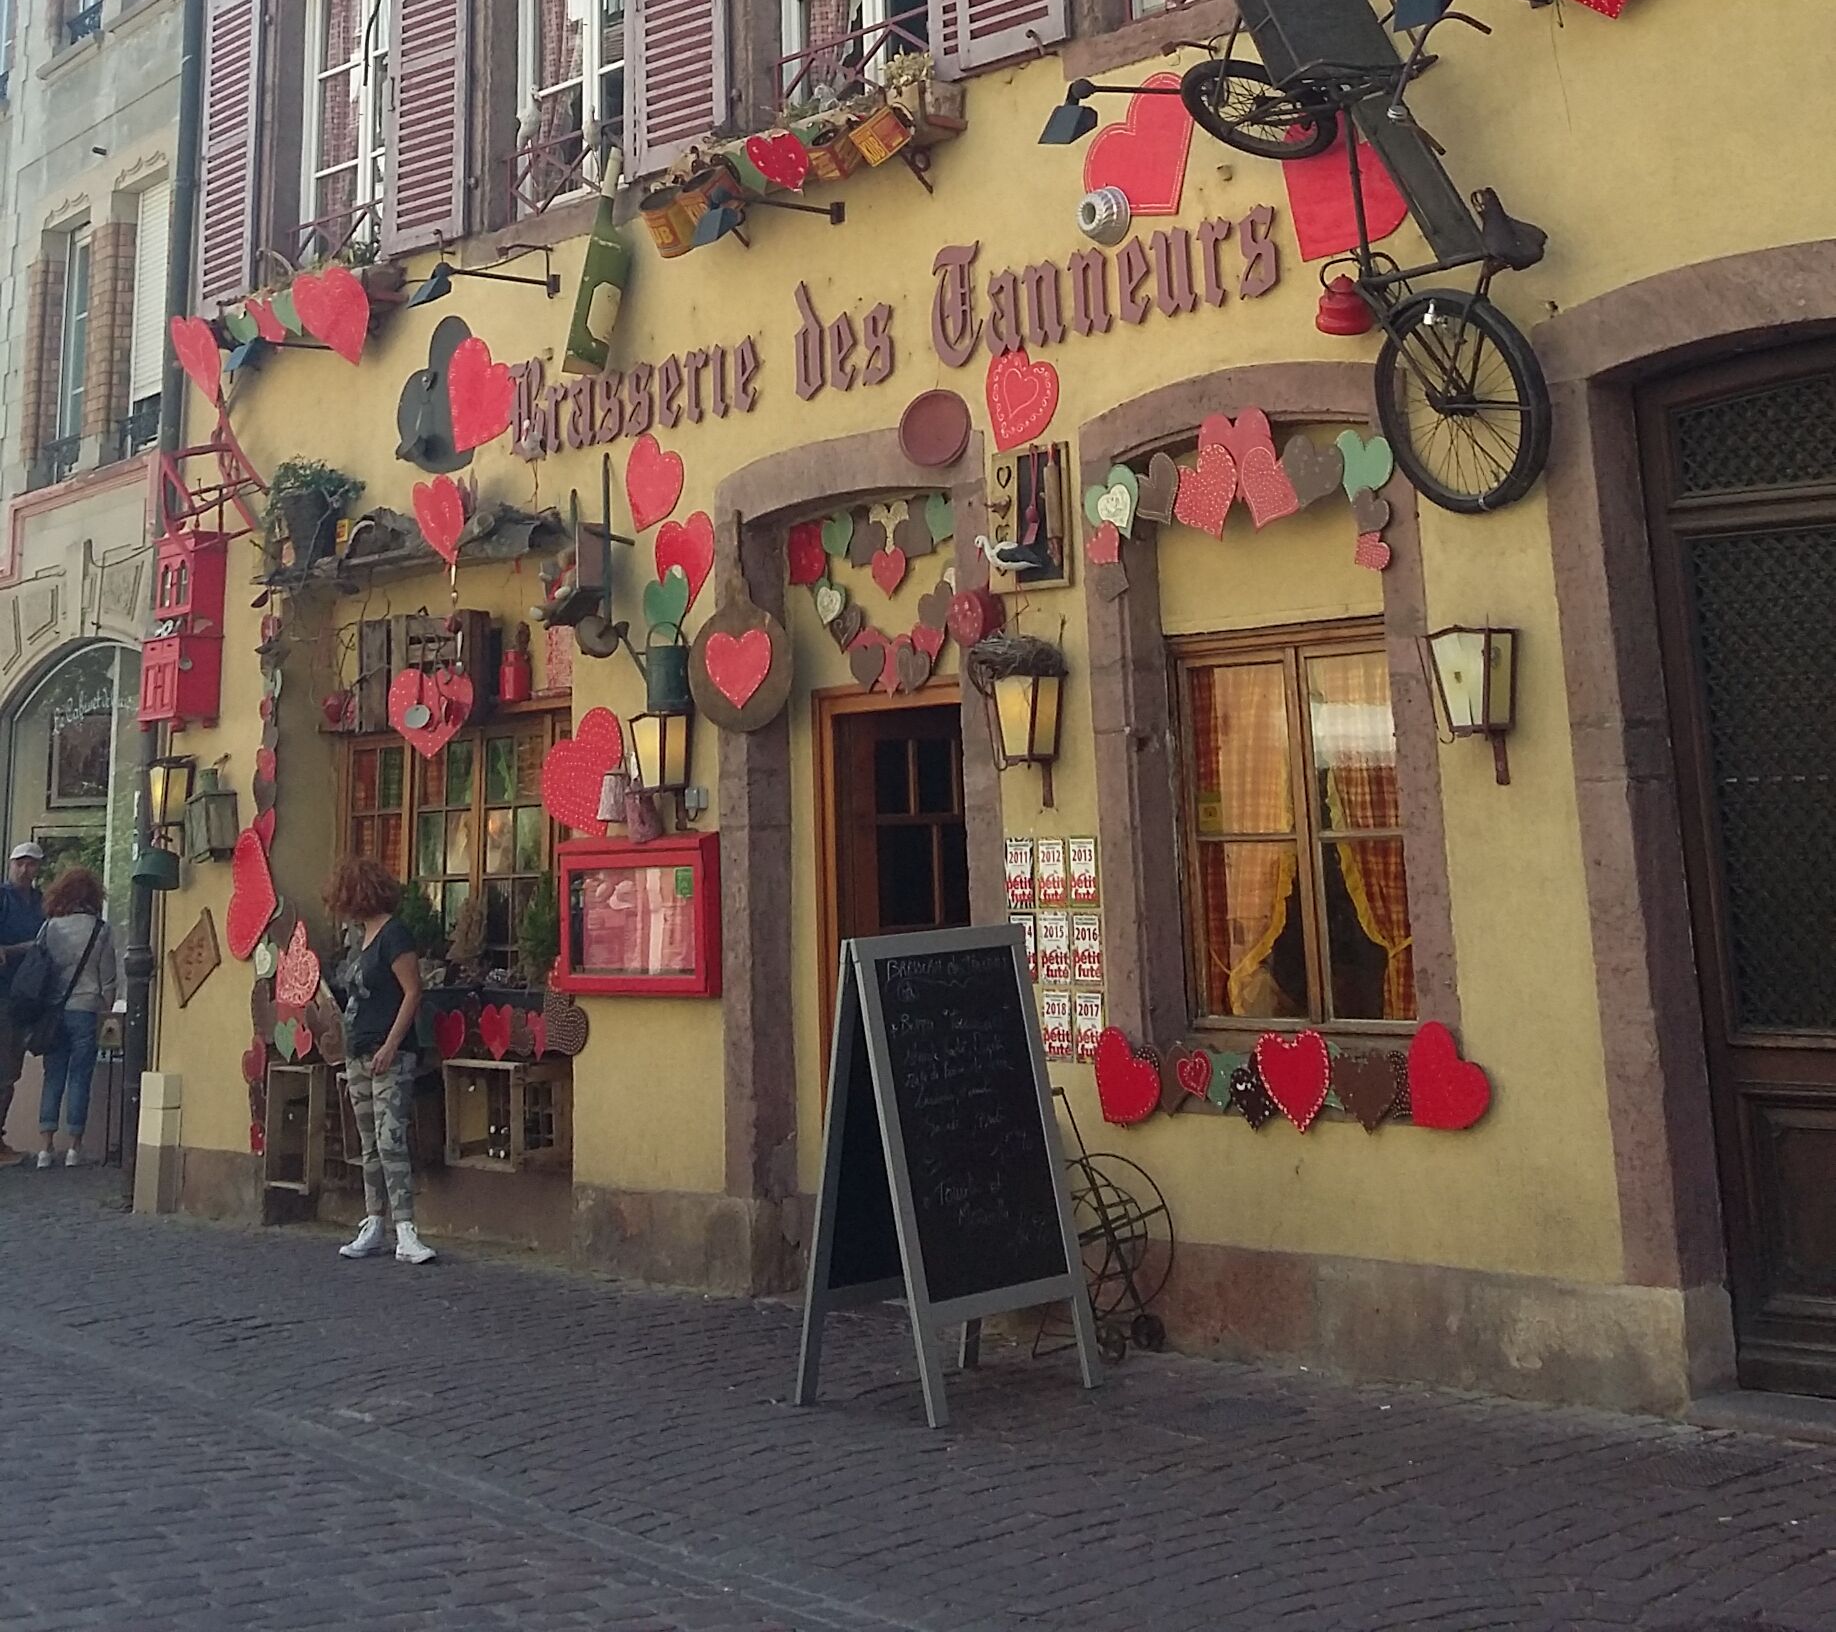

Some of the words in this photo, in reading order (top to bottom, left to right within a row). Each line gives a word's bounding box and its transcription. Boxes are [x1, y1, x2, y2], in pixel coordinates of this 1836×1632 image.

[509, 334, 760, 463] Brasserie
[794, 280, 893, 402] des
[931, 202, 1282, 368] Tanneurs
[1009, 851, 1028, 864] 2011
[1041, 850, 1061, 863] 2012
[1072, 848, 1093, 862] 2013
[1043, 925, 1064, 939] 2015
[1075, 927, 1098, 941] 2016
[1045, 1001, 1067, 1016] 2018
[1078, 1003, 1099, 1017] 2017
